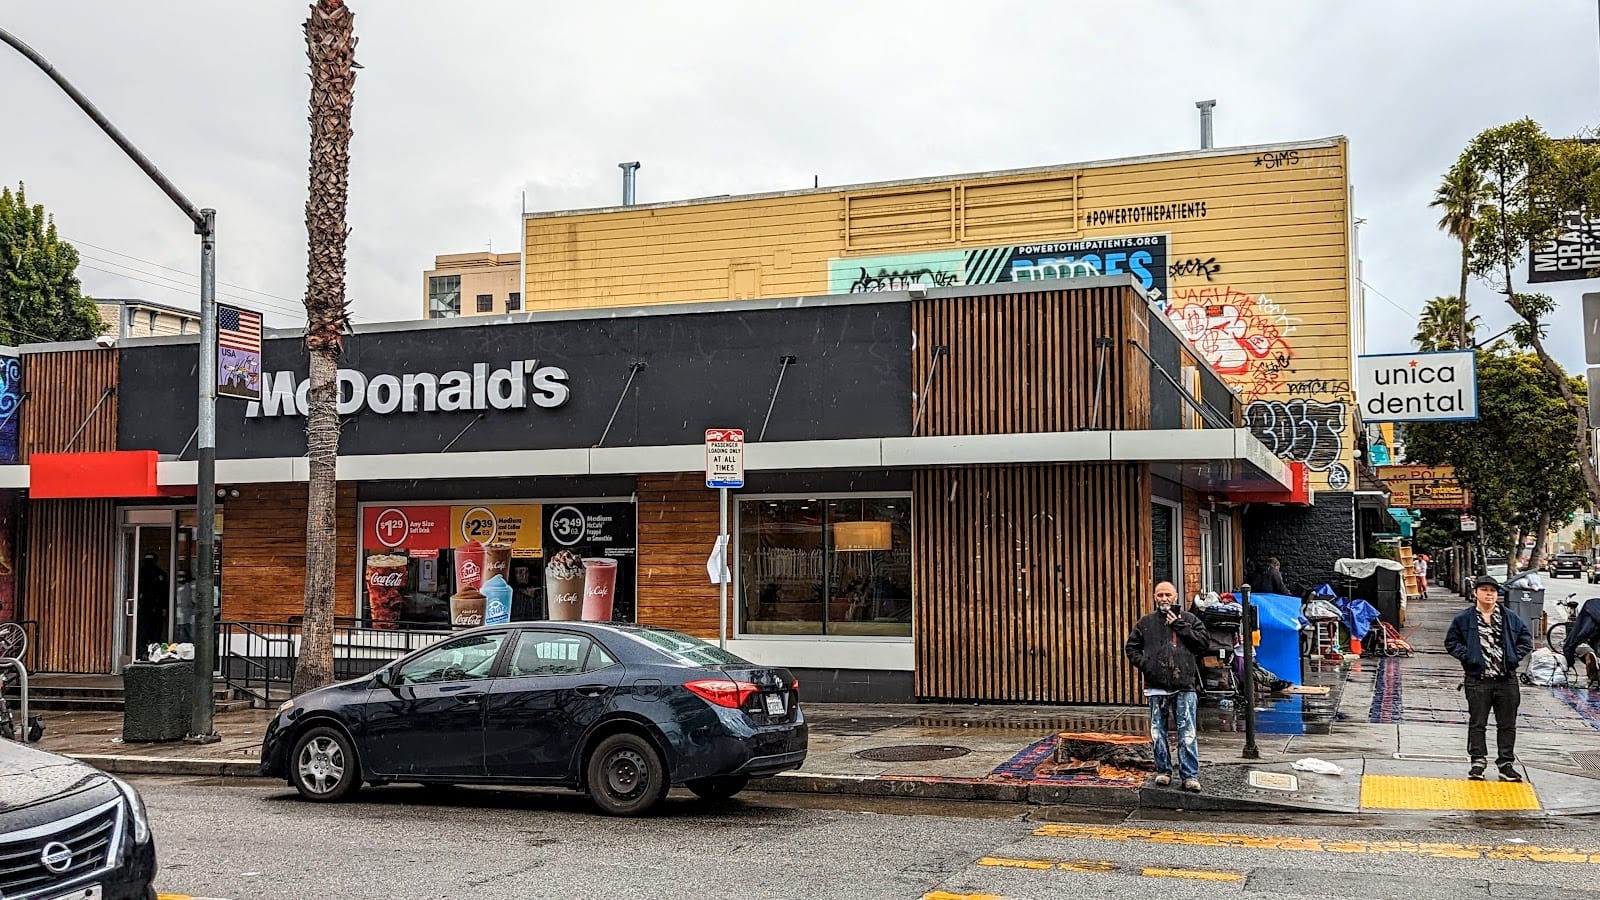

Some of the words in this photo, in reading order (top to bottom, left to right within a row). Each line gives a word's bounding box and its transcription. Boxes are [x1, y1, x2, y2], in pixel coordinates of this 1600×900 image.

[1086, 201, 1207, 226] #POWERTOTHEPATIENTS
[1018, 236, 1159, 254] POWERTOTHEPATIENTS.ORG
[221, 348, 237, 358] USA
[1375, 361, 1455, 385] unica
[1367, 389, 1464, 415] dental
